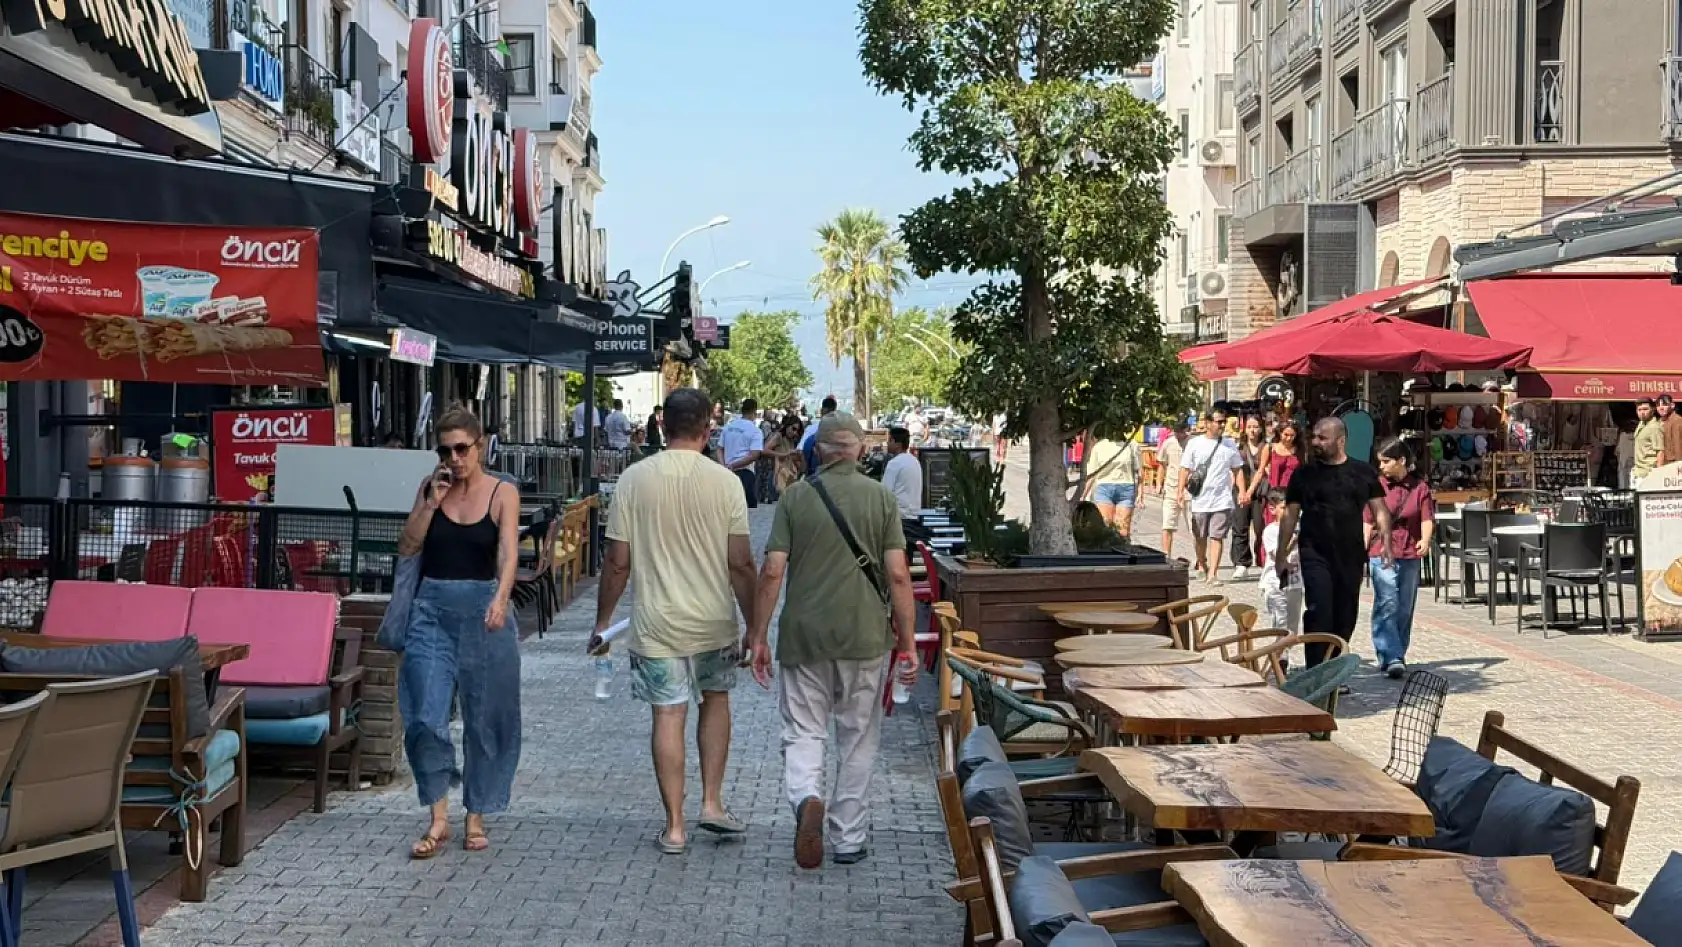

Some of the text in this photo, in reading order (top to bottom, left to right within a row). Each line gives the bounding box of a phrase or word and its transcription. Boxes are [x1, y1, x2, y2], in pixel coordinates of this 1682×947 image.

[23, 272, 92, 285] 2 Tavuk Dürüm
[22, 283, 29, 291] 2
[30, 283, 58, 294] Ayran
[67, 286, 74, 295] 2
[594, 340, 647, 350] SERVICE
[234, 452, 270, 464] Tavuk
